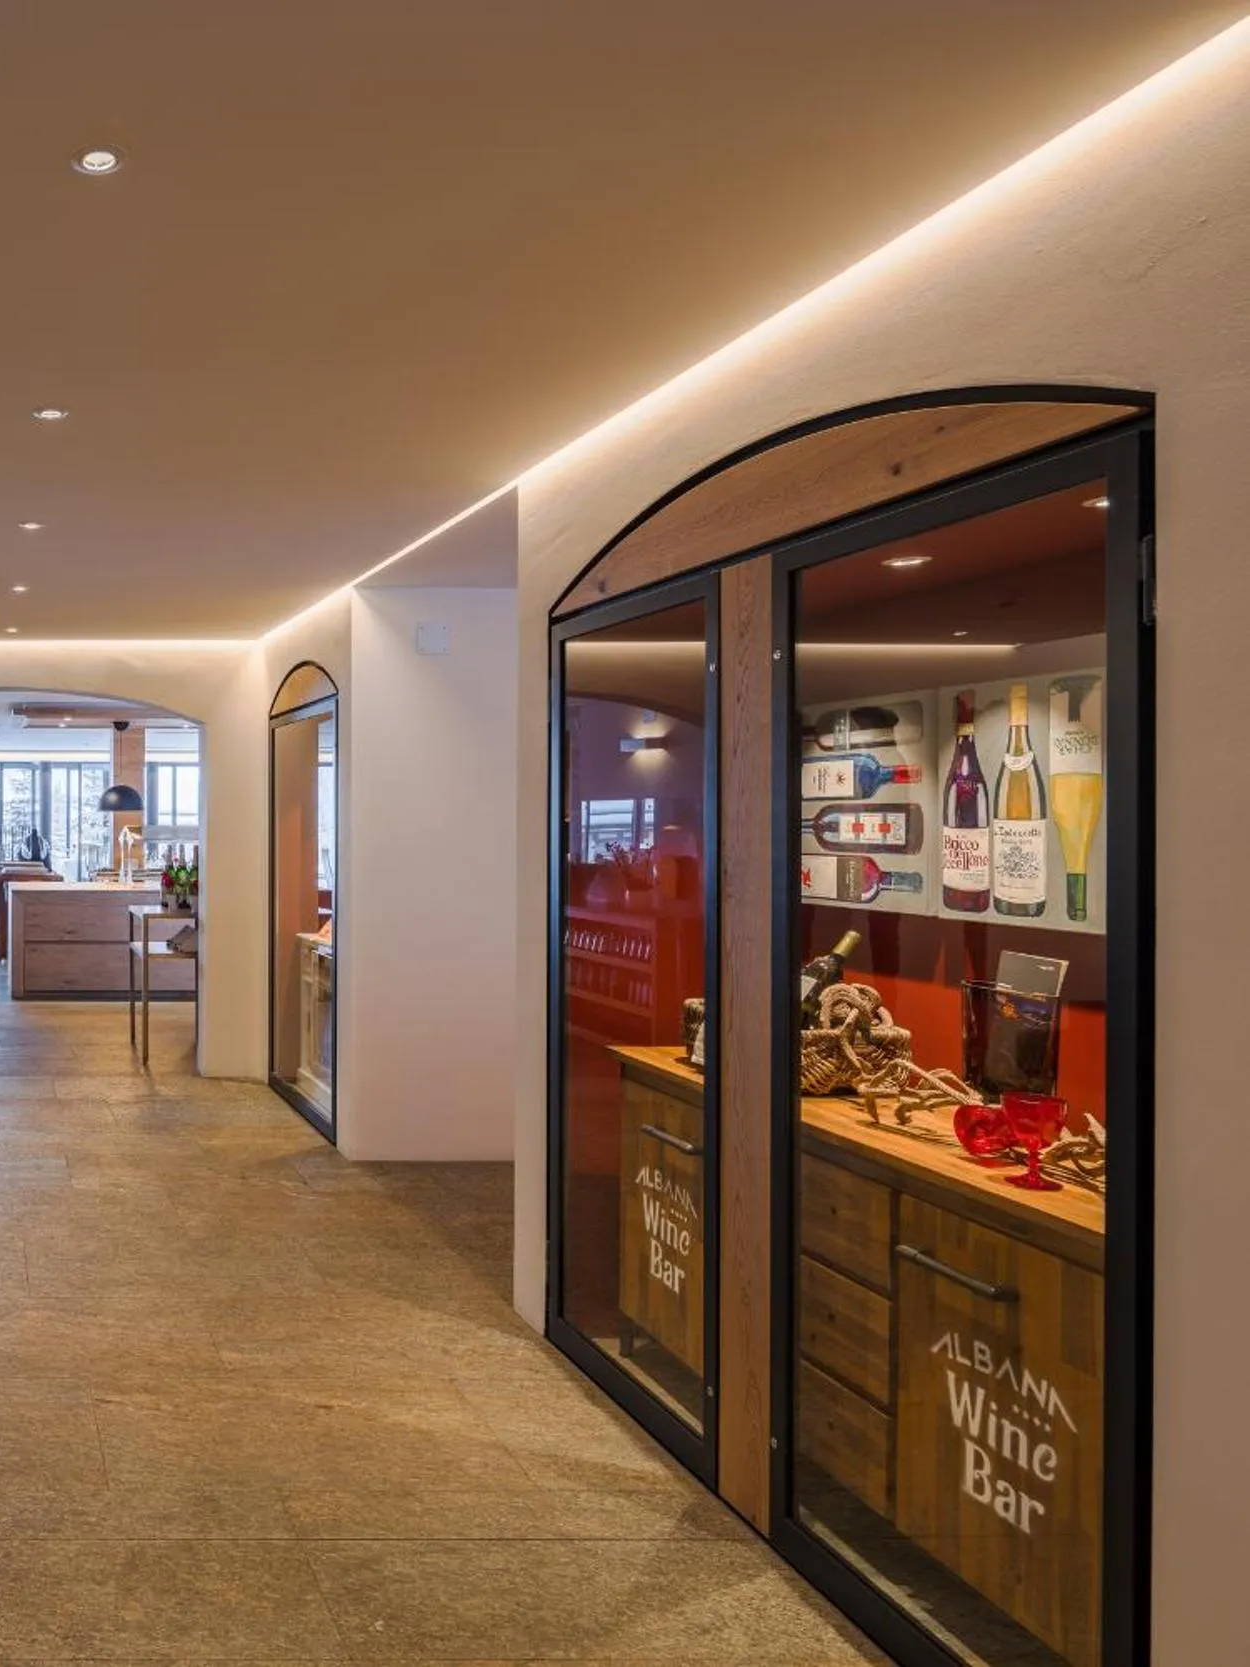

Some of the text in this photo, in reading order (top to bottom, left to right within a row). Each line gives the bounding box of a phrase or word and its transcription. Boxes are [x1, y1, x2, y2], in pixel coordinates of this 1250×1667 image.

[635, 1165, 698, 1219] ALBANA
[643, 1192, 690, 1256] Wine
[650, 1238, 686, 1294] Bar
[930, 1332, 1079, 1434] ALBANA
[946, 1368, 1058, 1481] Wine
[962, 1437, 1046, 1534] Bar
